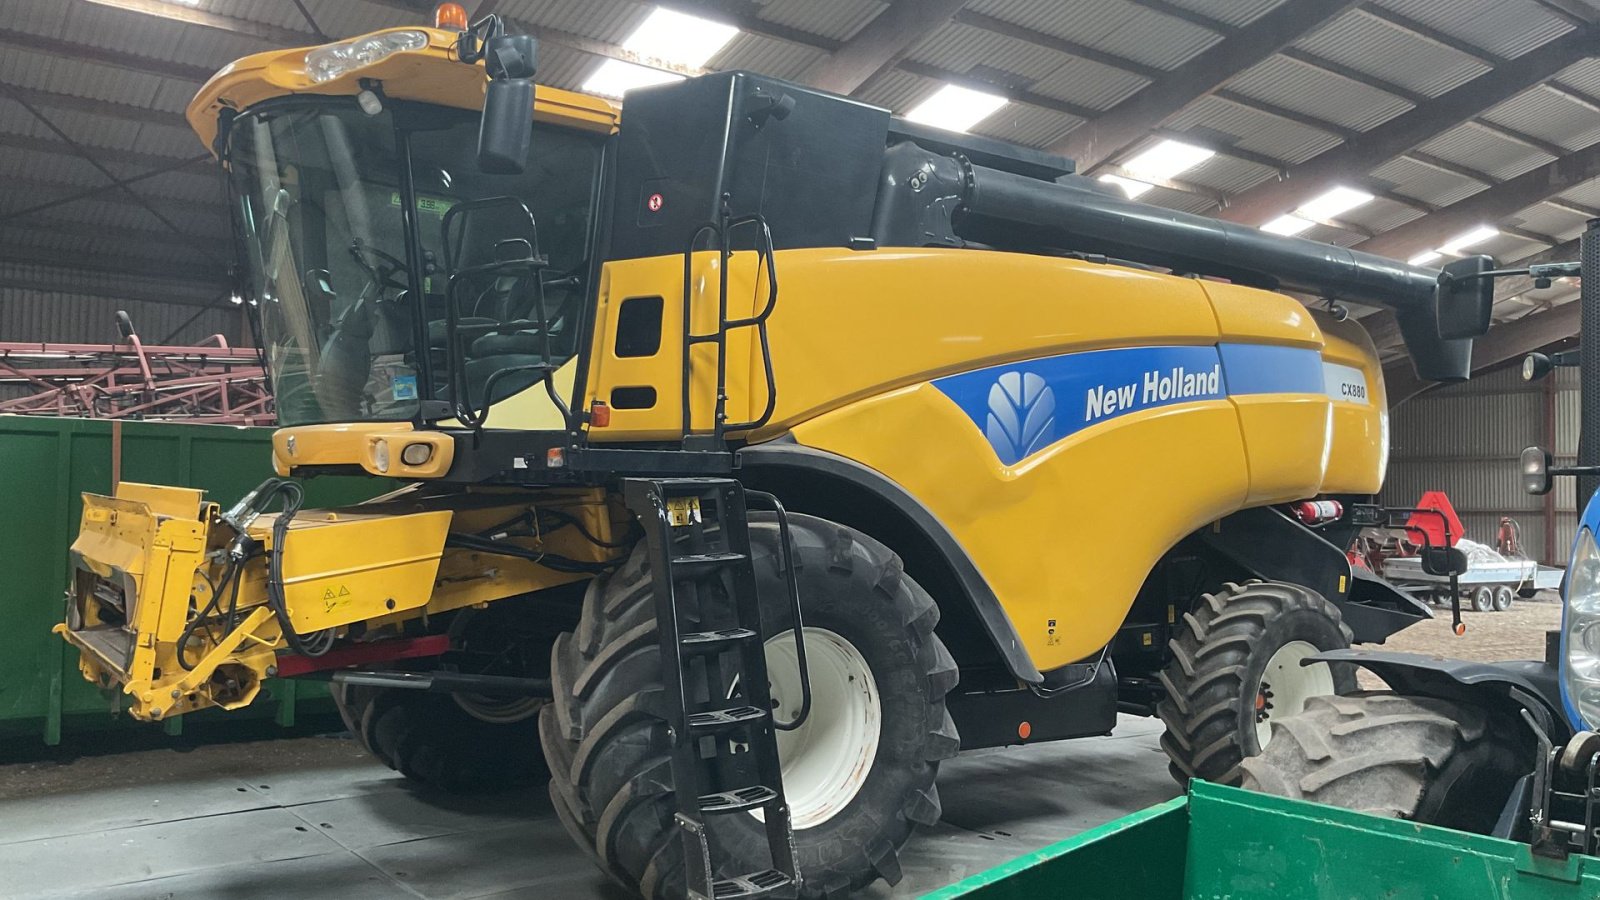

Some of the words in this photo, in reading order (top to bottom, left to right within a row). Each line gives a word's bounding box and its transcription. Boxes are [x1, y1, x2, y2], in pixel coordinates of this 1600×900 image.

[1086, 384, 1138, 422] New
[1142, 364, 1220, 404] Holland
[1341, 382, 1366, 399] CX880
